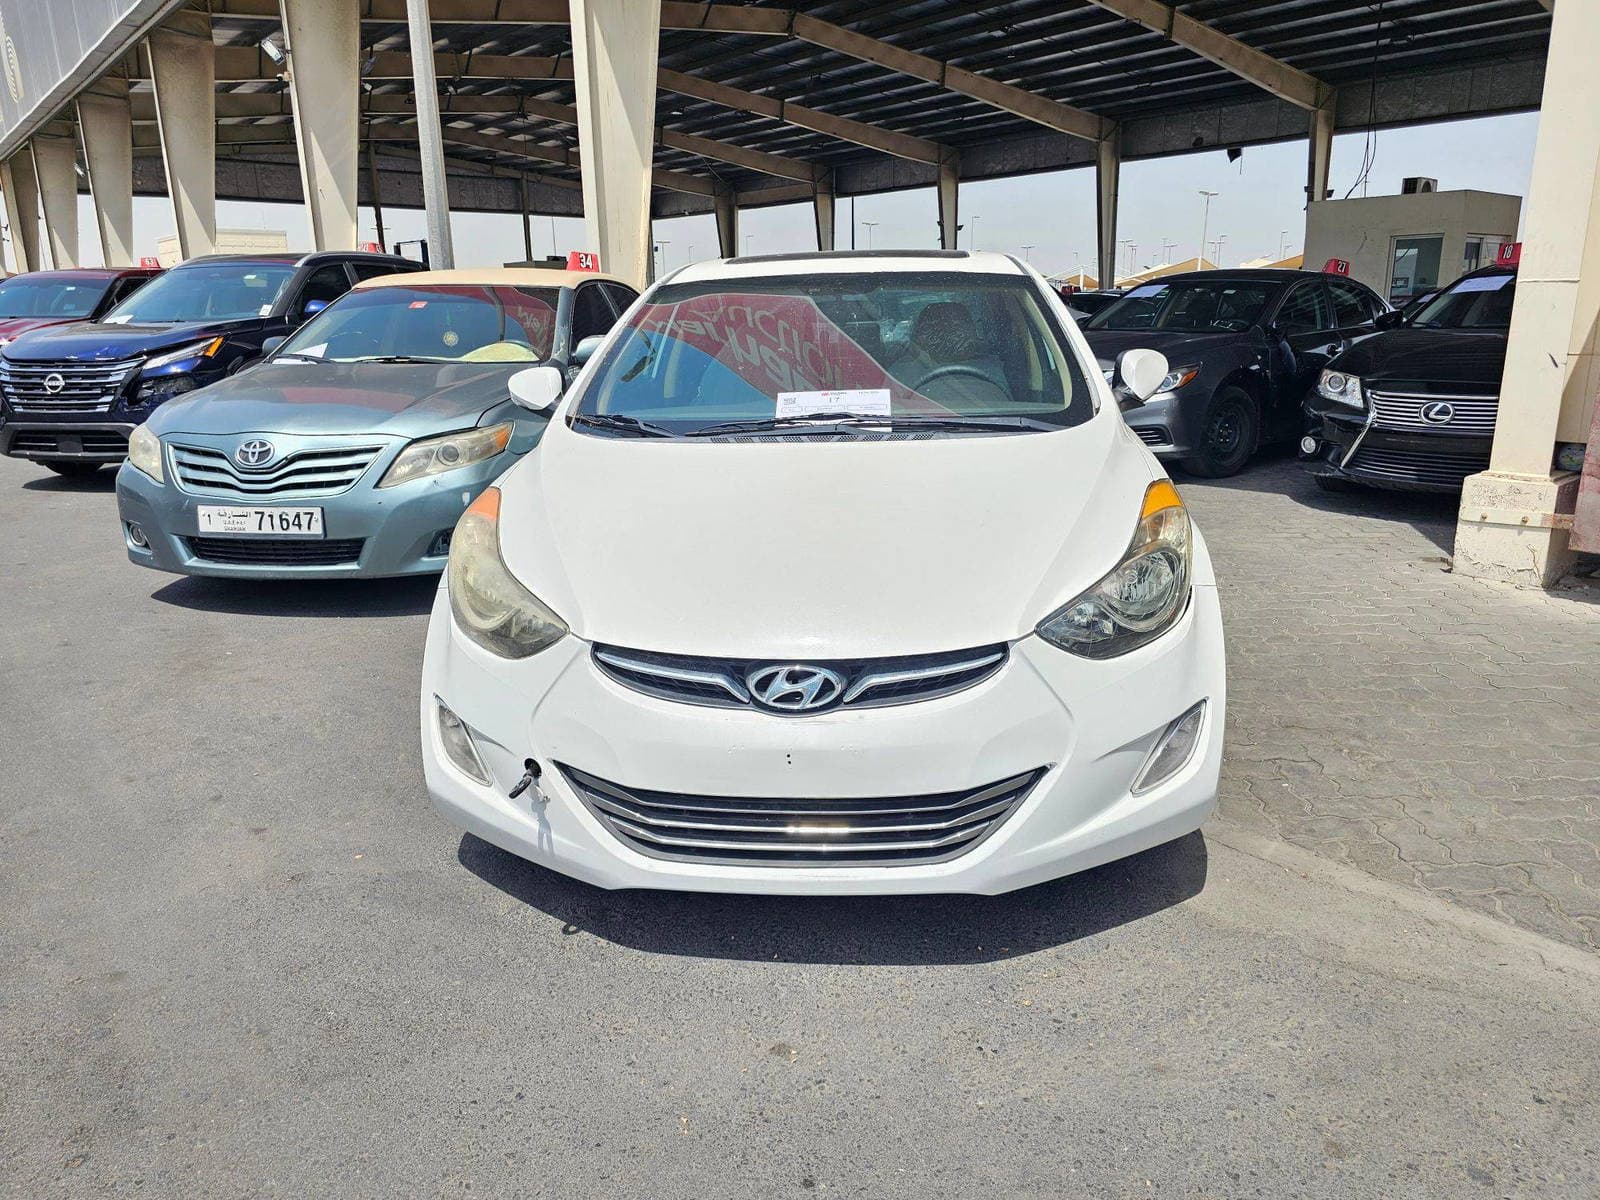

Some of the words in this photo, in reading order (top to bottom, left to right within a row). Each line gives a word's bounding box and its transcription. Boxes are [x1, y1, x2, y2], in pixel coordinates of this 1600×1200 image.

[579, 253, 593, 269] 34
[1337, 260, 1346, 273] 27
[207, 513, 212, 525] 1
[254, 511, 314, 531] 71647
